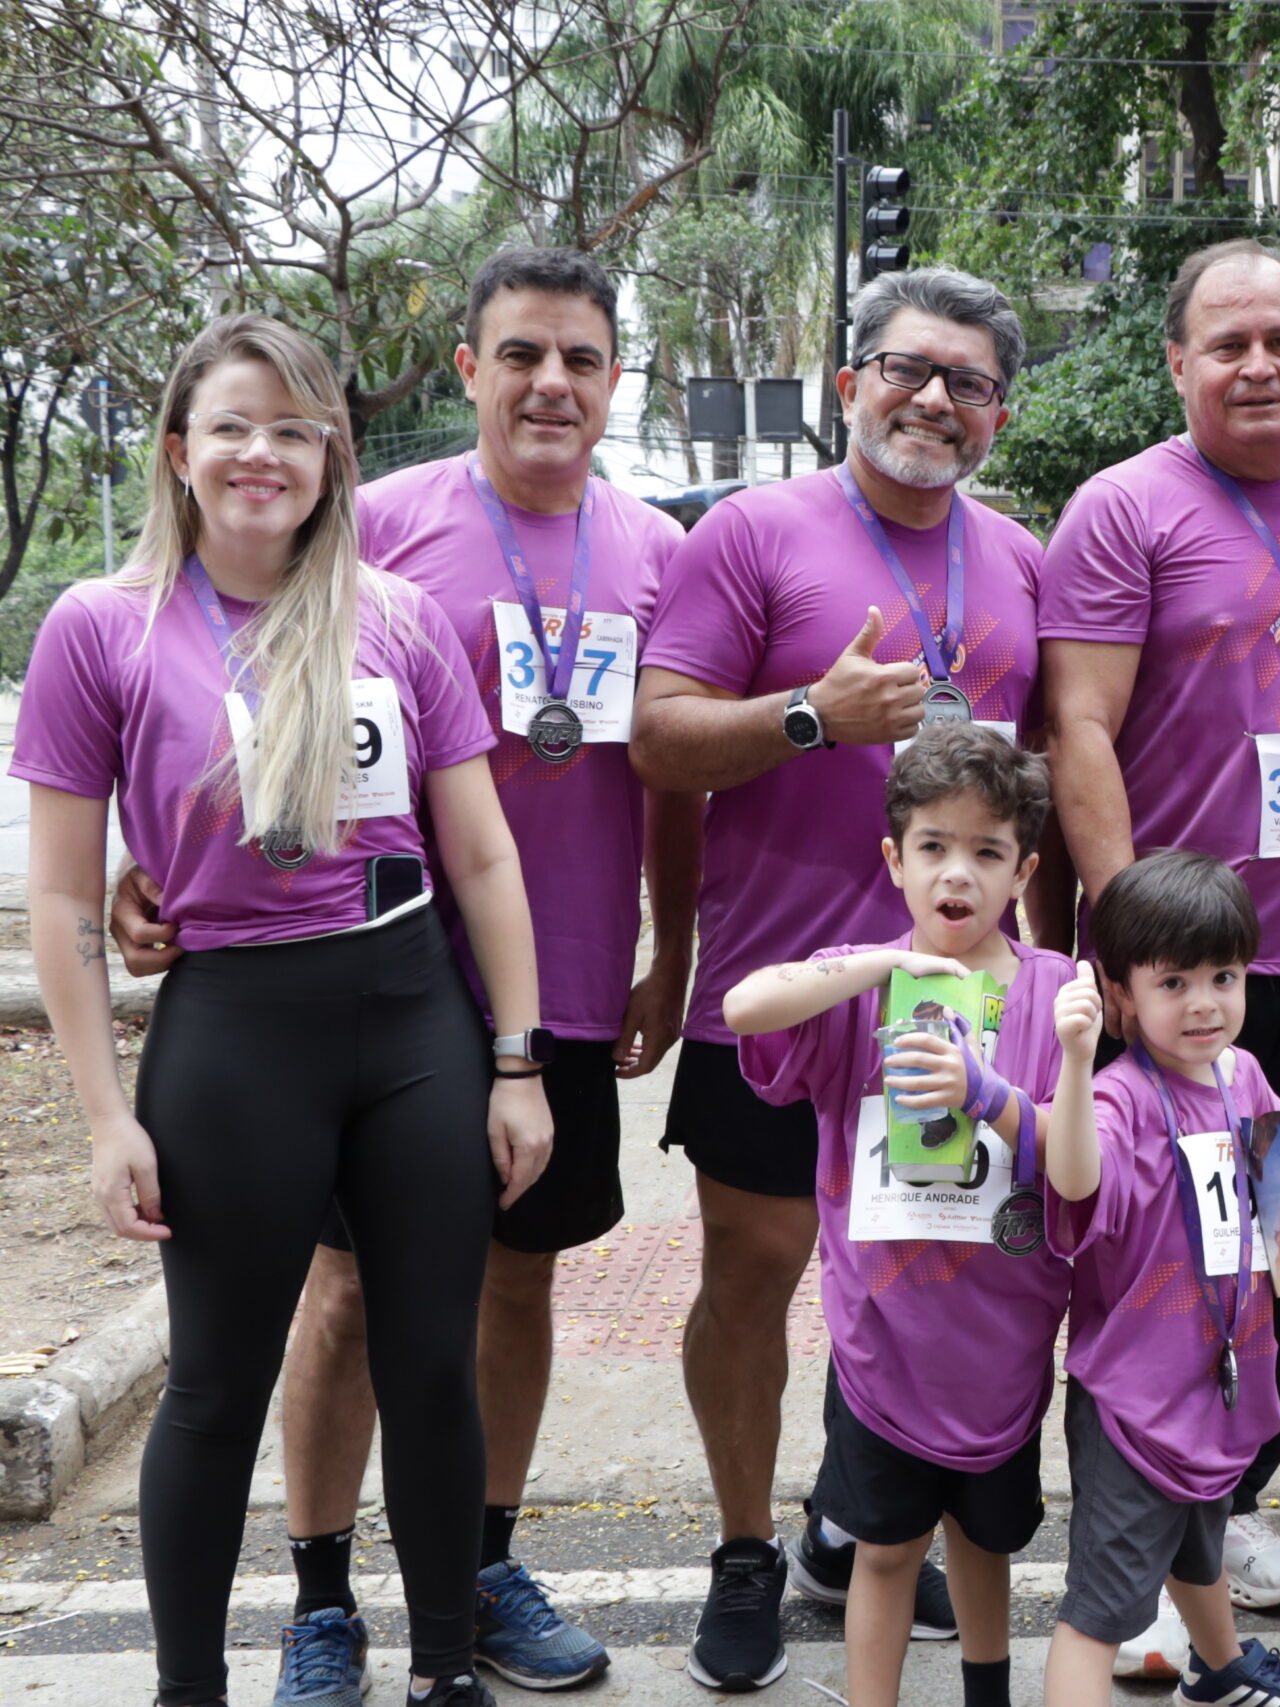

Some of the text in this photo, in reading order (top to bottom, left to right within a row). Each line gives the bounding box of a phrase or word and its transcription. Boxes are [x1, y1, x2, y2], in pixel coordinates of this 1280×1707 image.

[505, 641, 617, 697] 37
[569, 699, 604, 710] ISBINO
[872, 1192, 979, 1205] HENRIQUE ANDRADE
[1213, 1227, 1255, 1238] GUILHEE
